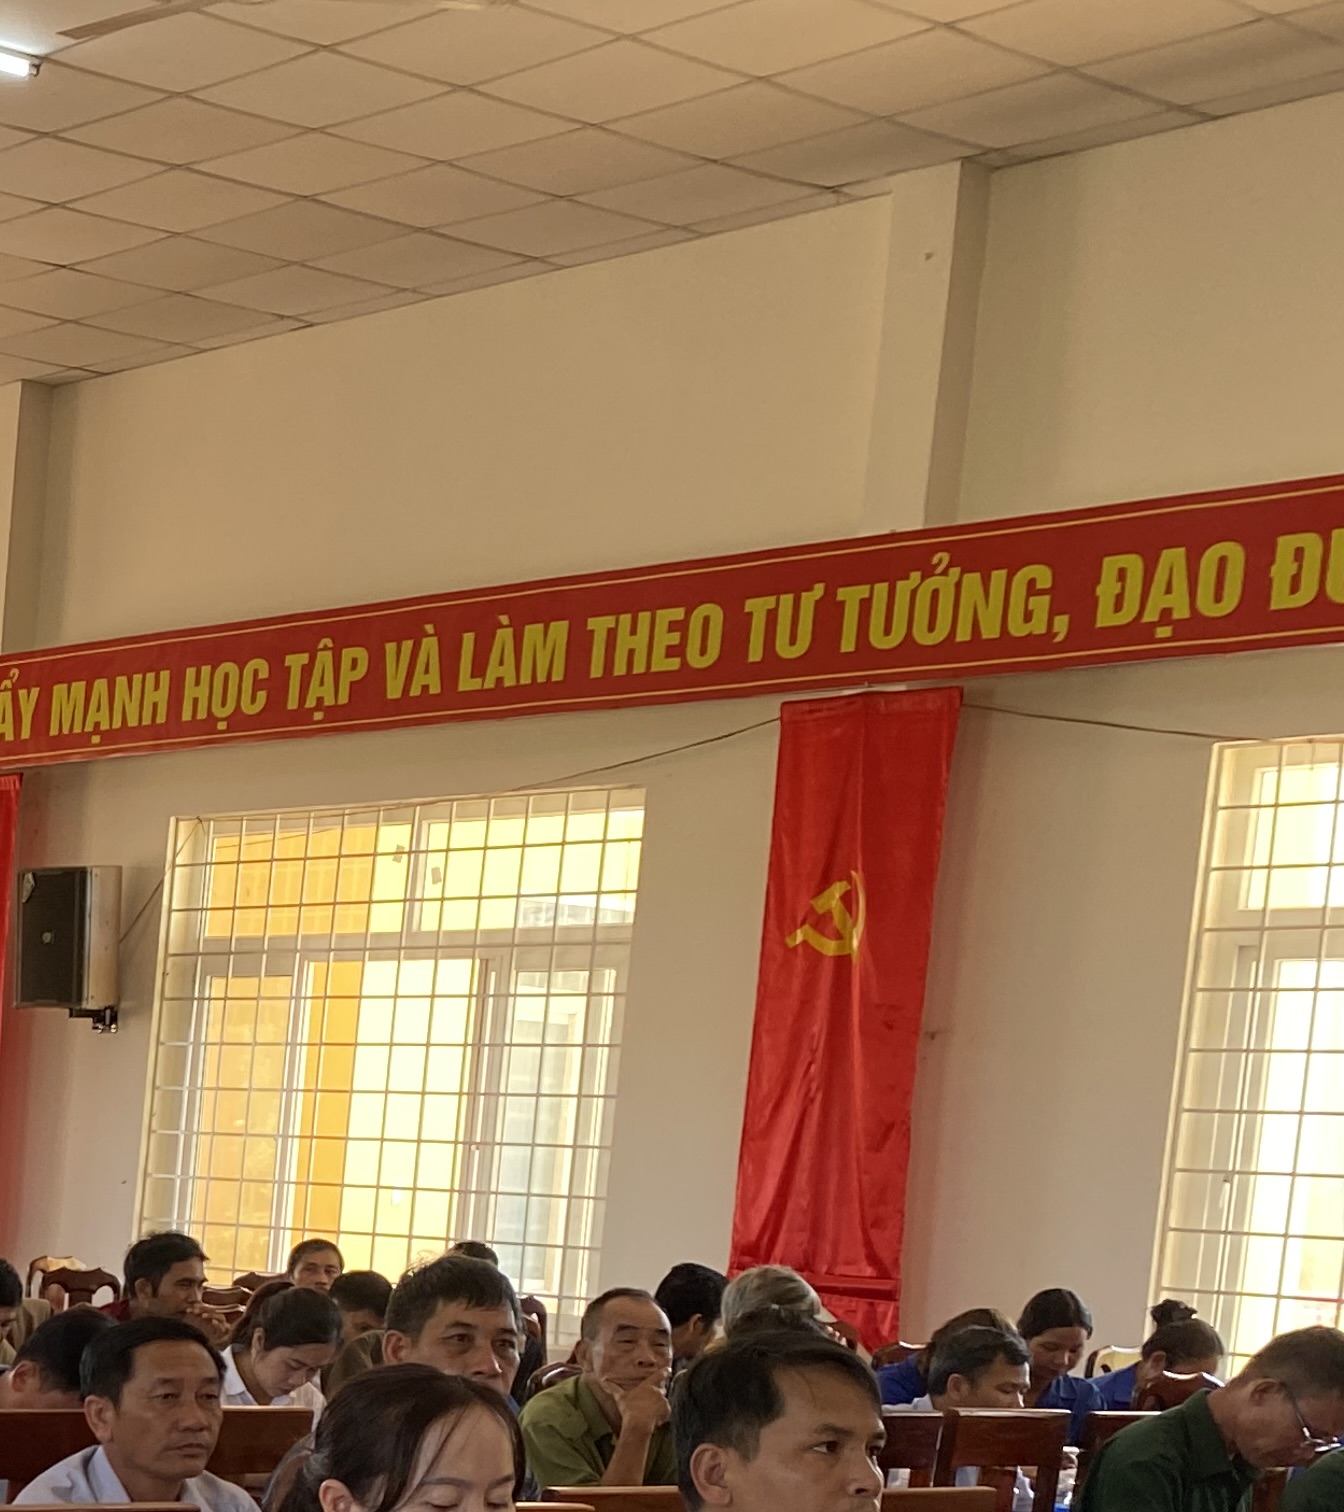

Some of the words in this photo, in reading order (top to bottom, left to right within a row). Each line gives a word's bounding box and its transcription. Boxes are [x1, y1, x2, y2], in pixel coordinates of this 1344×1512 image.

[50, 669, 171, 744] MẠNH
[182, 658, 271, 731] HỌC
[285, 637, 369, 721] TẬP
[385, 624, 441, 700] VÀ
[457, 615, 569, 691] LÀM
[587, 602, 724, 679] THEO
[744, 583, 826, 663] TƯ
[837, 552, 1069, 653] TƯỞNG,
[1095, 540, 1246, 638] ĐẠO
